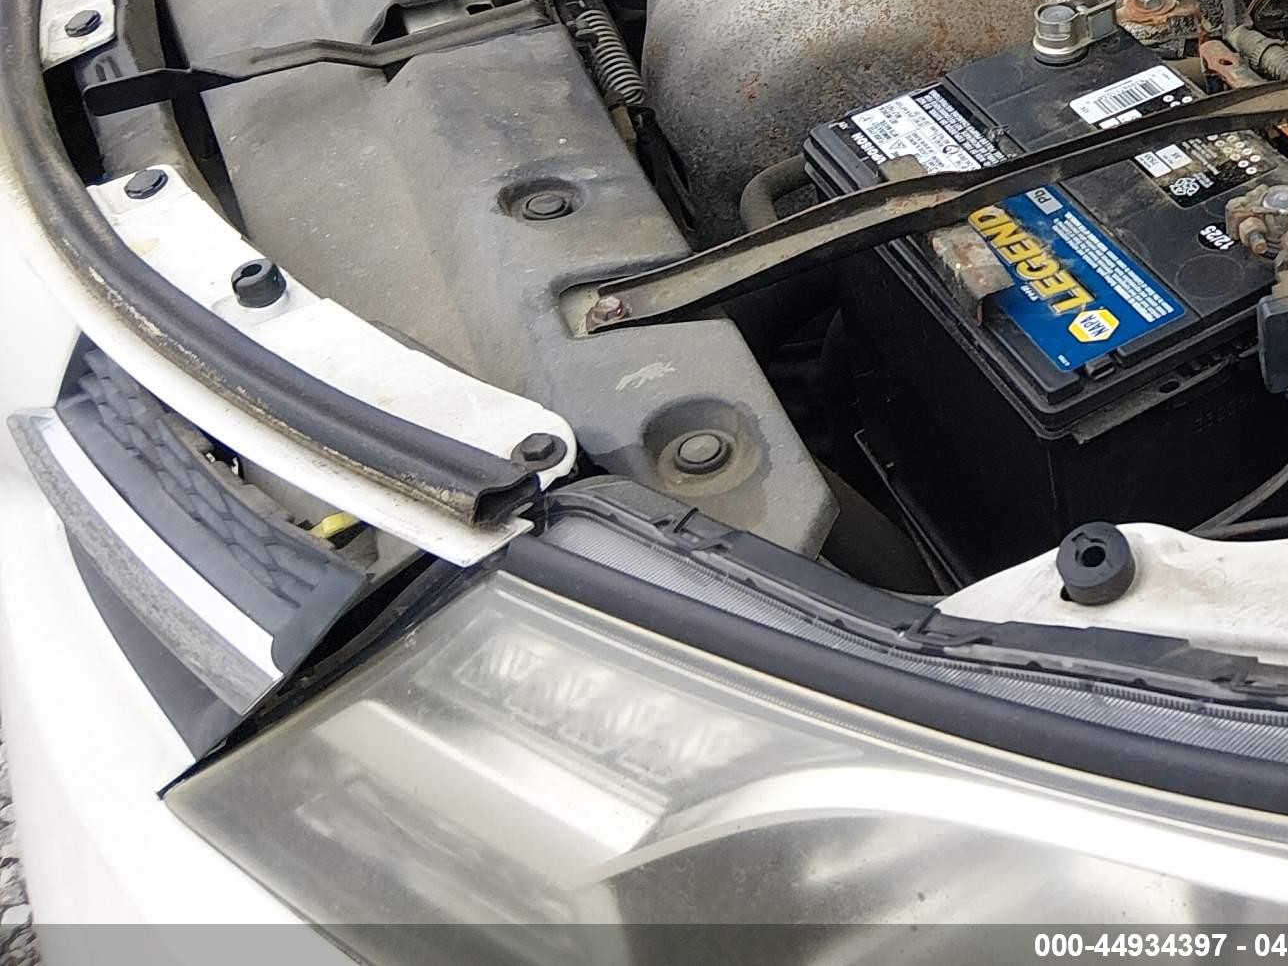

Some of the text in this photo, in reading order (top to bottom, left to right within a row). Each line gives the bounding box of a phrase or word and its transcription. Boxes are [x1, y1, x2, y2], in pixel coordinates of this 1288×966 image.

[1034, 189, 1051, 204] Pb
[1200, 225, 1235, 250] 12/25
[968, 205, 1096, 316] LEGEND
[1081, 315, 1109, 338] NAPA
